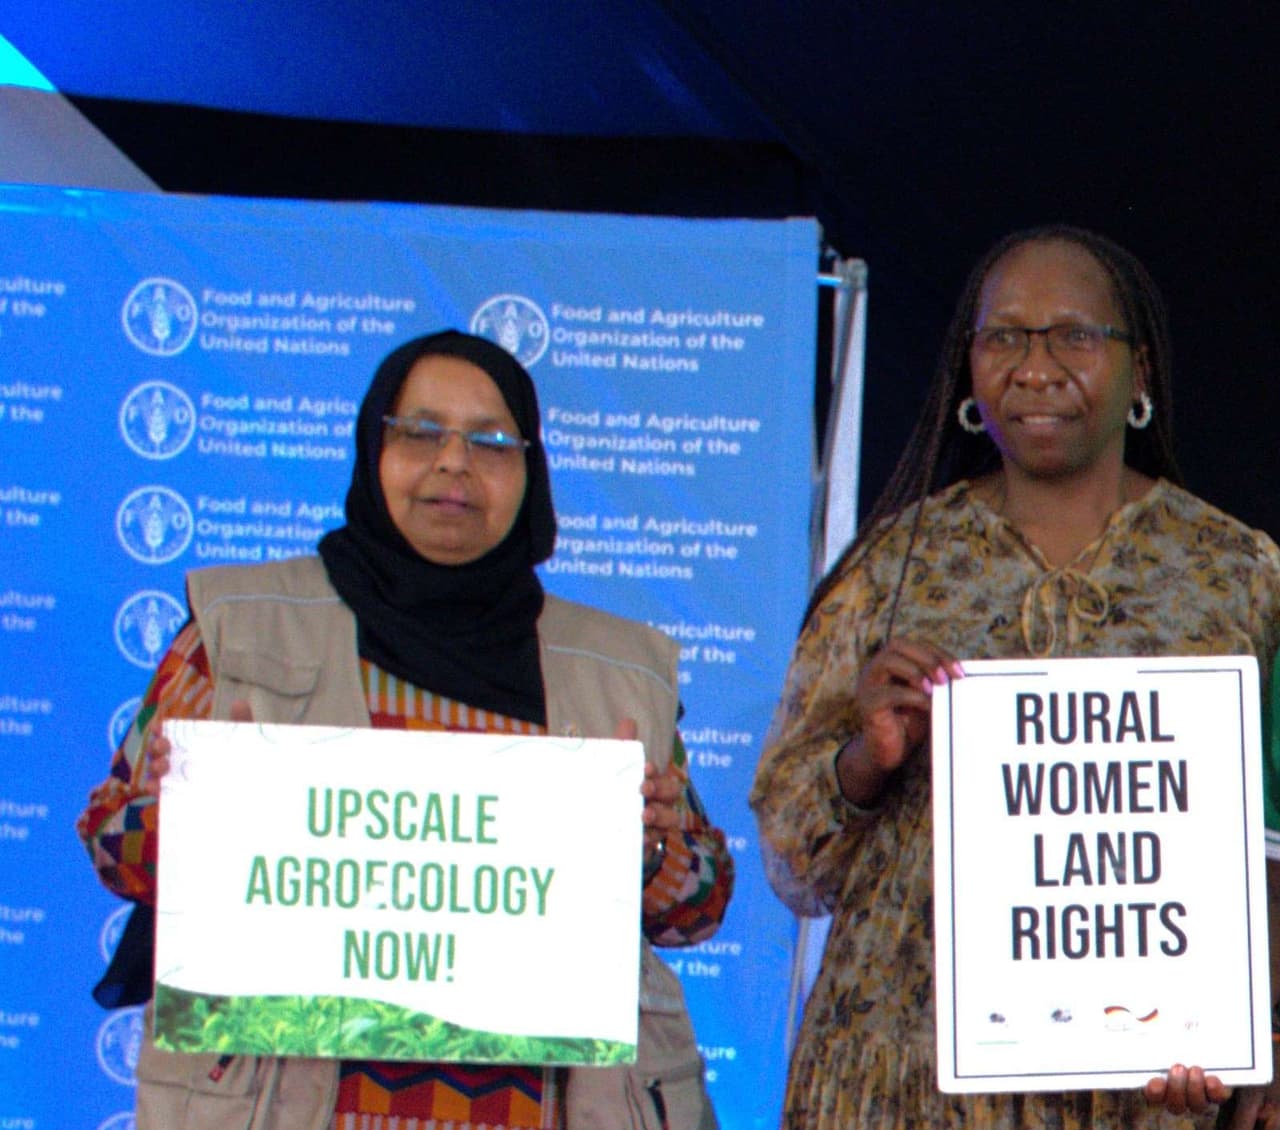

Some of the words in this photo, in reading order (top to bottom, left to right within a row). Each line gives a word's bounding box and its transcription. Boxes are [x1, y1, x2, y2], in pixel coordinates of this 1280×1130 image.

[203, 289, 252, 307] Food
[259, 291, 295, 308] and
[302, 292, 416, 313] Agriculture
[202, 312, 331, 334] Organization
[337, 315, 357, 333] of
[361, 317, 395, 335] the
[551, 304, 600, 321] Food
[609, 306, 645, 324] and
[651, 307, 764, 328] Agriculture
[201, 335, 268, 354] United
[274, 337, 349, 357] Nations
[552, 328, 679, 348] Organization
[686, 331, 706, 348] of
[711, 332, 744, 350] the
[552, 351, 615, 369] United
[622, 353, 699, 373] Nations
[202, 393, 249, 411] Food
[255, 395, 292, 412] and
[201, 416, 328, 436] Organization
[549, 408, 599, 426] Food
[605, 411, 640, 428] and
[646, 412, 760, 433] Agriculture
[199, 438, 266, 457] United
[272, 442, 347, 460] Nations
[549, 429, 676, 451] Organization
[682, 436, 702, 454] of
[706, 438, 741, 455] the
[550, 454, 614, 472] United
[621, 457, 695, 476] Nations
[198, 496, 246, 513] Food
[252, 499, 291, 516] and
[557, 515, 597, 531] ood
[602, 515, 639, 531] and
[645, 518, 758, 538] Agriculture
[197, 541, 262, 560] United
[680, 543, 701, 558] of
[705, 544, 738, 560] the
[546, 559, 613, 577] United
[618, 561, 694, 580] Nations
[703, 647, 736, 664] the
[1015, 690, 1175, 745] RURAL
[699, 751, 731, 767] the
[1001, 759, 1189, 816] WOMEN
[307, 787, 499, 844] UPSCALE
[1034, 831, 1162, 887] LAND
[245, 855, 555, 916] AGROECOLOGY
[1011, 901, 1188, 961] RIGHTS
[343, 929, 456, 982] NOW!
[688, 961, 720, 977] the
